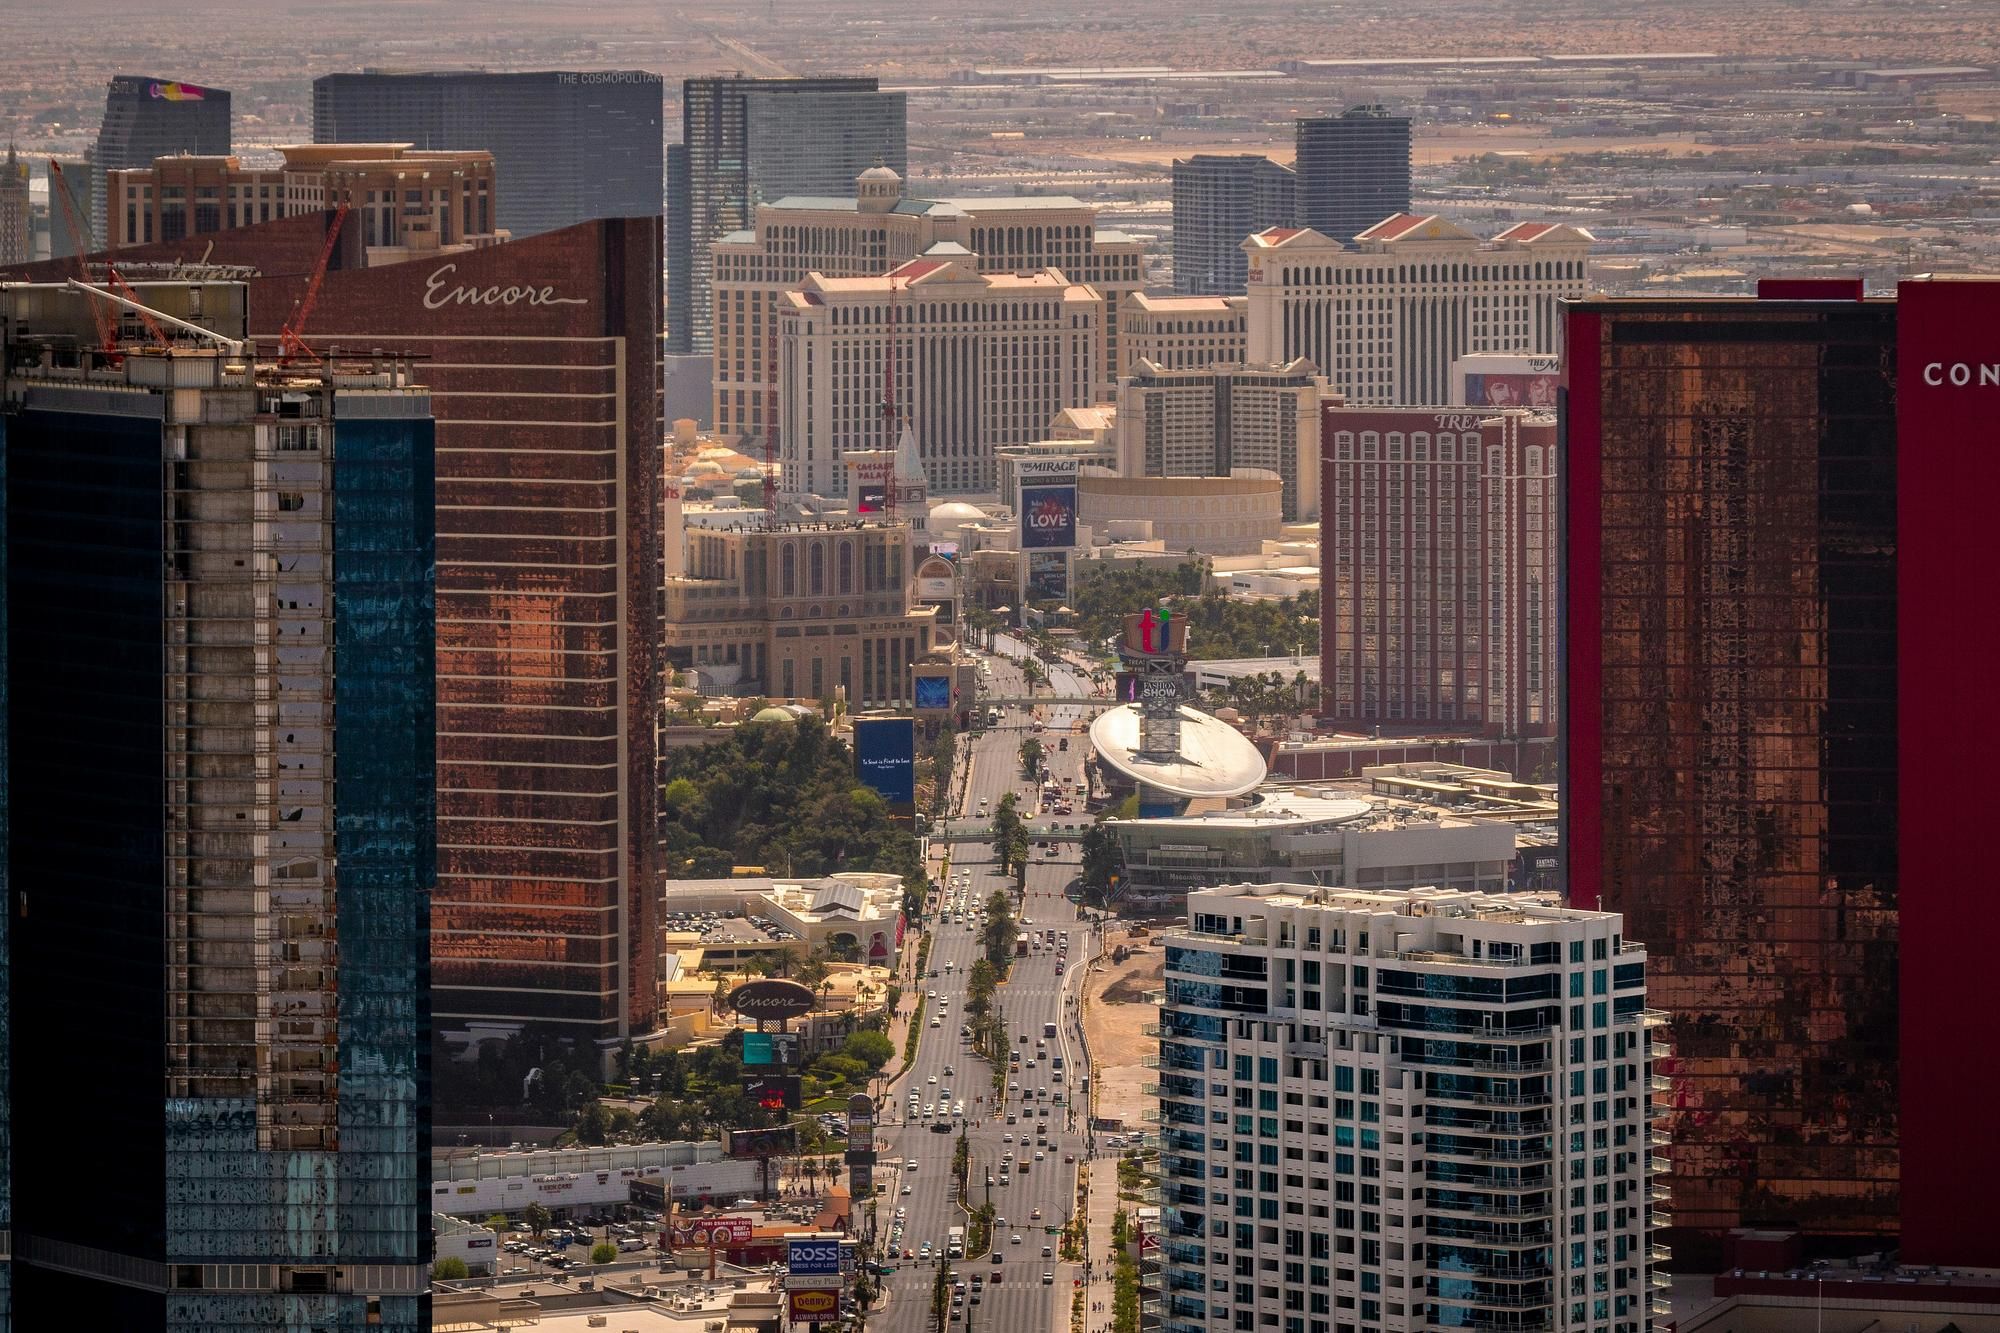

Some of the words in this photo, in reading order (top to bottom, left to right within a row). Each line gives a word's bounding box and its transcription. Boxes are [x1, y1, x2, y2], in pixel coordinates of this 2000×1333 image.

[558, 74, 578, 84] THE
[581, 72, 662, 84] COSMOPOLITAN
[423, 263, 588, 309] Encore
[1924, 362, 2000, 386] CON
[1023, 461, 1077, 472] MIRAGE
[1031, 514, 1068, 527] LOVE
[1143, 681, 1176, 689] FASHION
[1143, 688, 1176, 697] SHOW
[736, 989, 810, 1008] Encore
[791, 1248, 837, 1260] ROSS
[787, 1279, 806, 1287] Silver
[806, 1278, 821, 1287] City
[797, 1297, 832, 1306] Denny's
